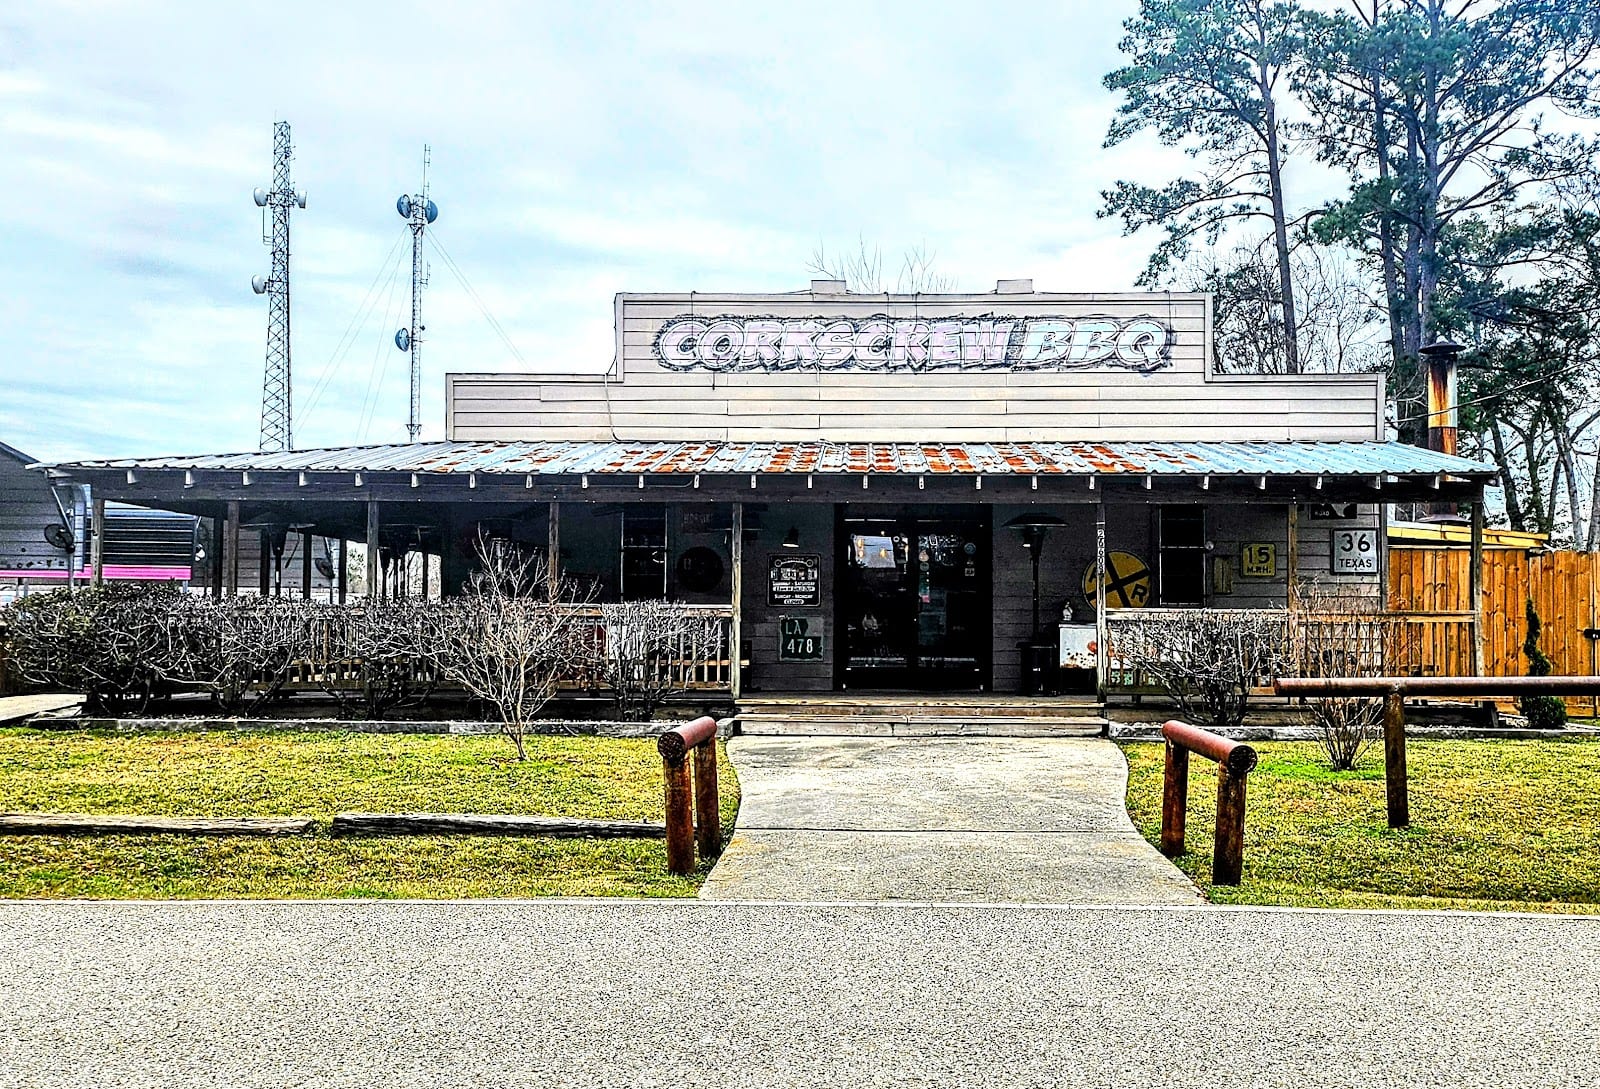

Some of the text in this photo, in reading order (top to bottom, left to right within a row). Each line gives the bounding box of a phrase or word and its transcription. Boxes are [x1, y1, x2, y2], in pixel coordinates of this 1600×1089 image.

[659, 316, 1167, 370] CORKSCREW BBQ
[1341, 533, 1371, 552] 36
[1247, 546, 1271, 564] 15
[1339, 558, 1372, 568] TEXAS
[785, 620, 802, 635] LA
[786, 638, 814, 654] 478
